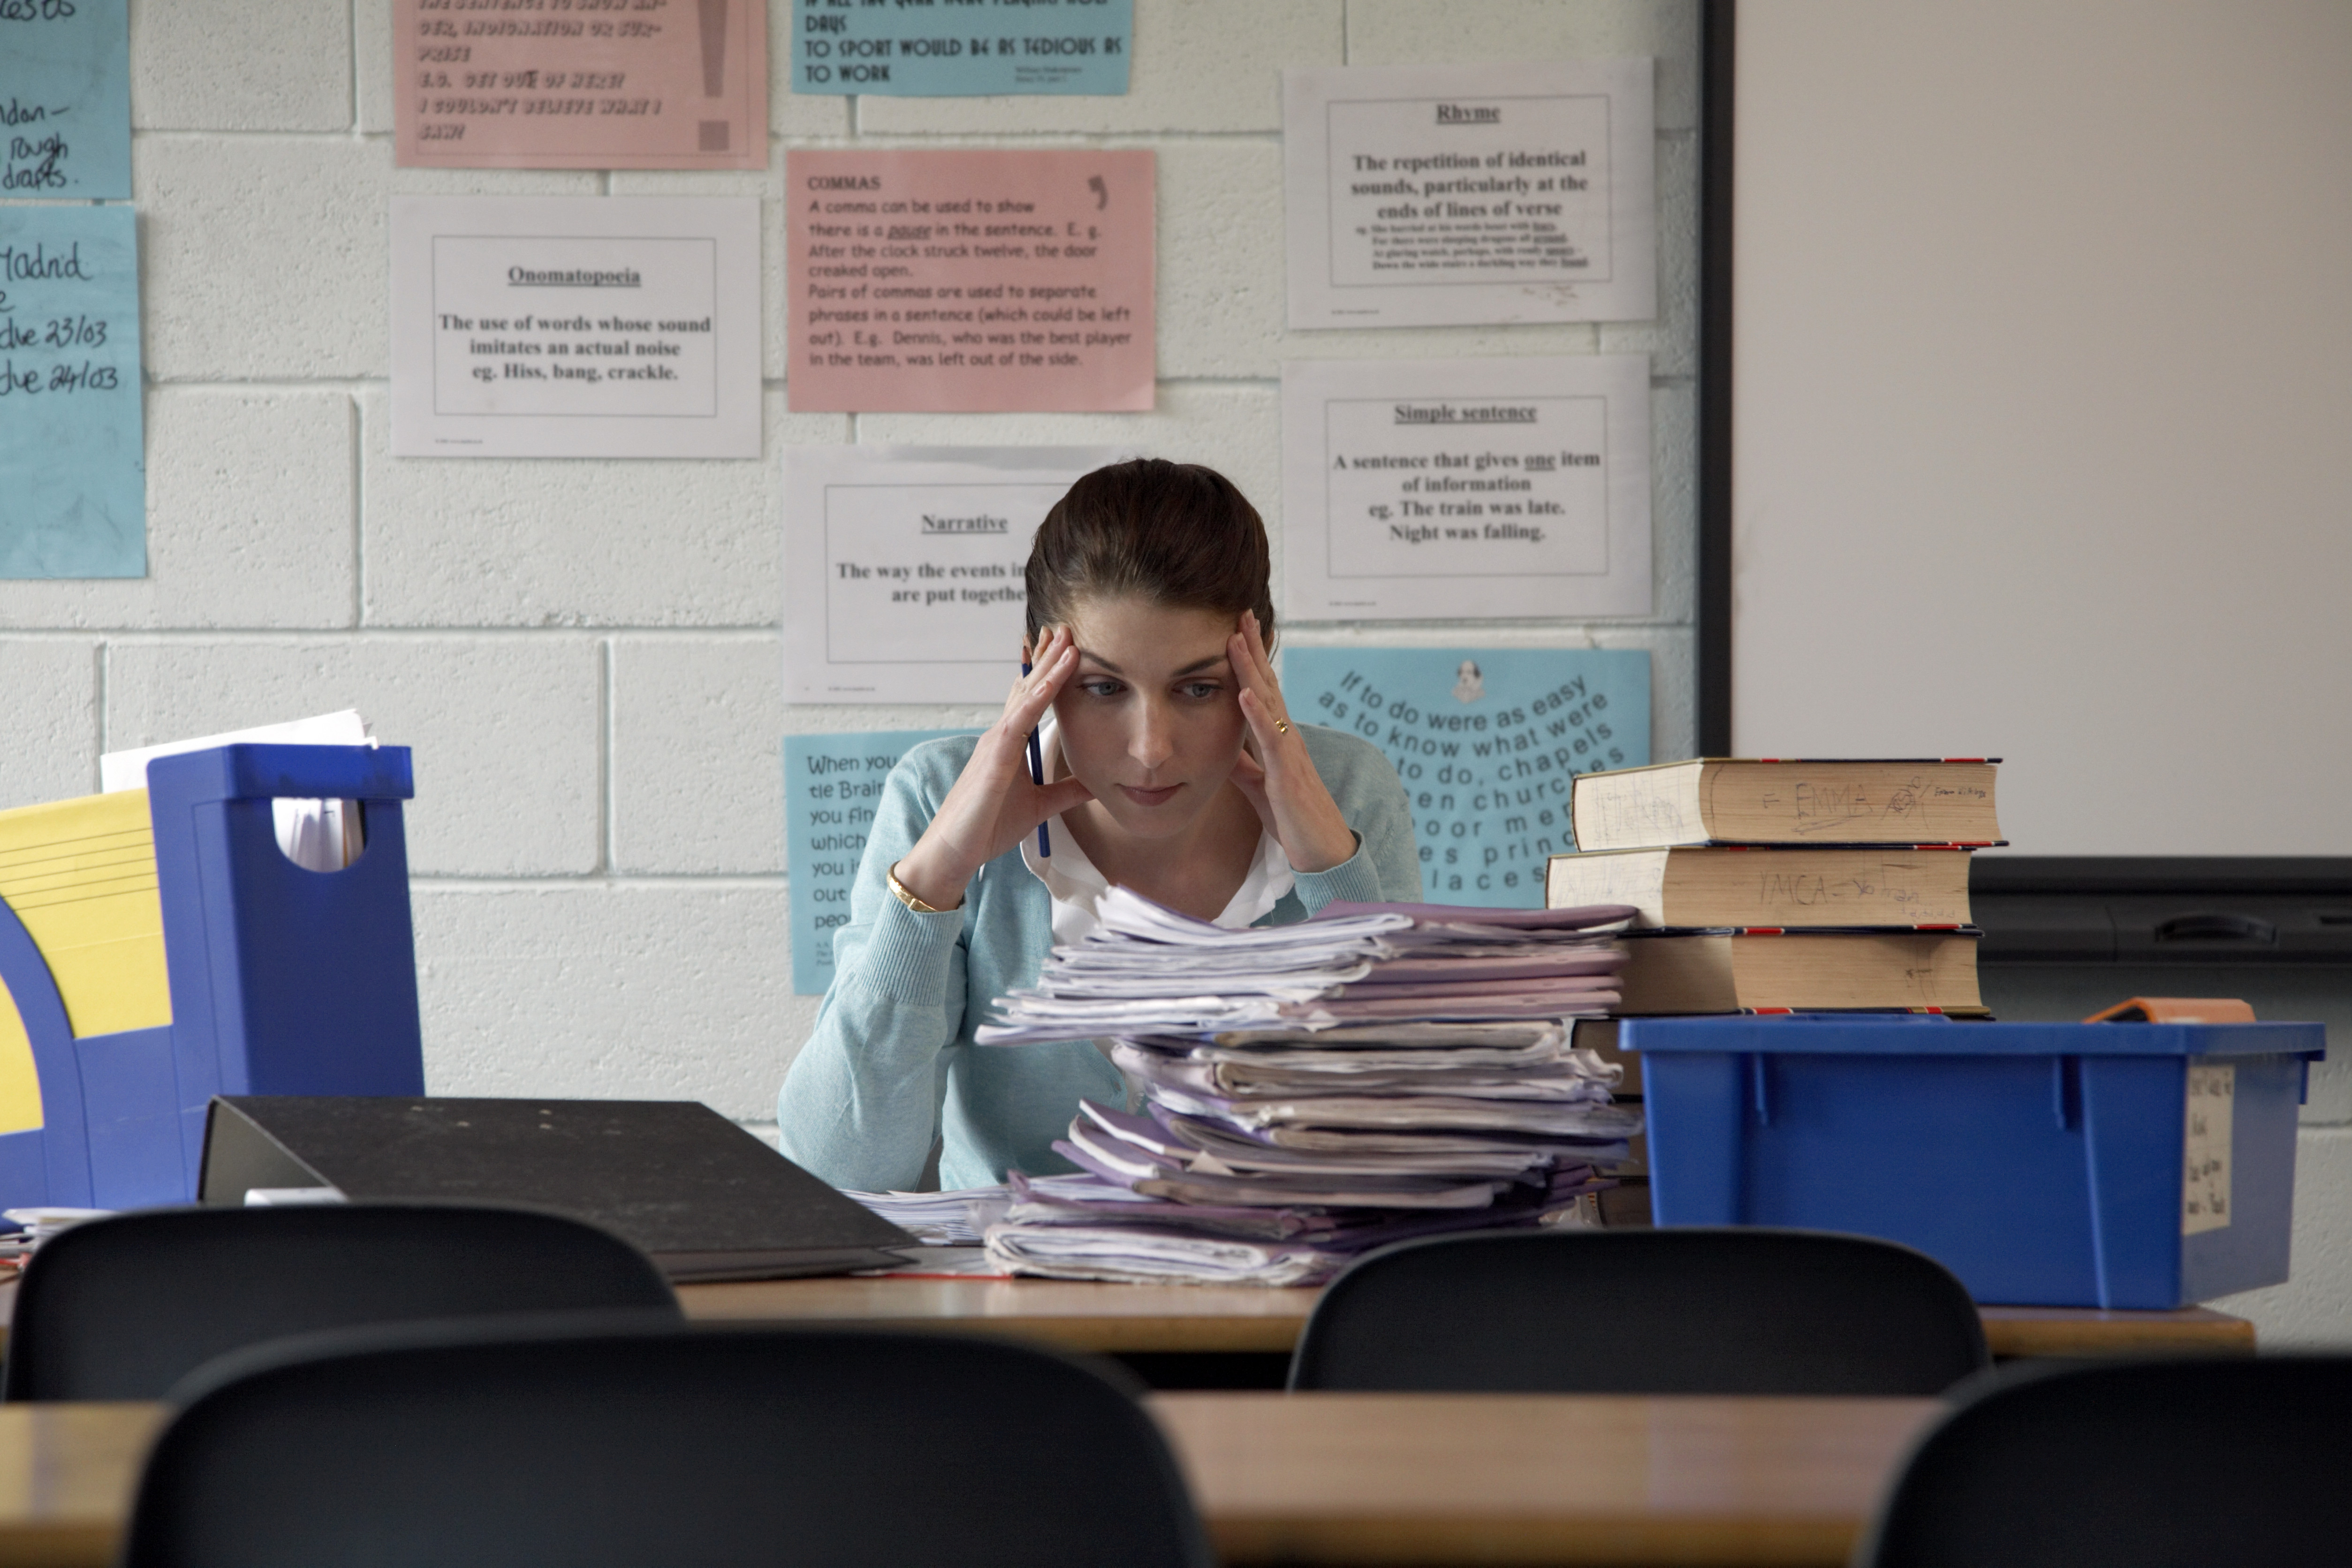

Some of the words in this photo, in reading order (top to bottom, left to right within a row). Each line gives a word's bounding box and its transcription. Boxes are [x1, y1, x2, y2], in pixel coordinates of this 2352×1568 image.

[804, 39, 832, 59] TO
[838, 39, 892, 58] SPORT
[899, 38, 963, 57] WOULD
[970, 38, 989, 56] BE
[998, 38, 1015, 55] AS
[1023, 37, 1096, 56] TEDIOUS
[1104, 37, 1121, 54] AS
[804, 64, 832, 83] TO
[839, 64, 890, 83] WORK
[1436, 104, 1500, 125] Rhyme
[12, 132, 68, 165] rough
[1354, 155, 1388, 171] The
[1393, 153, 1480, 174] repetition
[1485, 151, 1504, 168] of
[1508, 151, 1586, 167] identical
[807, 176, 880, 190] COMMAS
[1351, 178, 1419, 195] sounds,
[1424, 176, 1530, 198] particularly
[1537, 178, 1554, 191] at
[1560, 175, 1588, 191] the
[809, 200, 819, 212] A
[825, 202, 877, 214] comma
[881, 201, 908, 214] can
[911, 200, 931, 213] be
[935, 199, 971, 213] used
[997, 199, 1035, 213] show
[1377, 203, 1419, 219] ends
[1423, 201, 1443, 218] of
[1446, 202, 1487, 218] lines
[1492, 200, 1512, 216] of
[1516, 204, 1562, 216] verse
[809, 223, 851, 237] there
[887, 225, 933, 241] pause
[954, 222, 979, 236] the
[984, 223, 1056, 237] sentence.
[808, 244, 846, 258] After
[851, 244, 876, 258] the
[880, 244, 919, 258] clock
[924, 243, 970, 258] struck
[973, 243, 1028, 258] twelve,
[1034, 244, 1060, 258] the
[1063, 244, 1097, 258] door
[508, 267, 641, 288] Onomatopoeia
[808, 264, 868, 278] creaked
[872, 266, 913, 280] open.
[808, 283, 847, 299] Pairs
[873, 287, 933, 299] commas
[936, 287, 963, 299] are
[967, 284, 1004, 299] used
[1029, 285, 1096, 302] separate
[439, 314, 473, 330] The
[479, 319, 508, 331] use
[513, 315, 533, 331] of
[537, 316, 592, 332] words
[598, 316, 652, 332] whose
[658, 317, 711, 333] sound
[808, 308, 869, 325] phrases
[905, 309, 974, 322] sentence
[978, 307, 1028, 324] (which
[1032, 307, 1073, 322] could
[1077, 308, 1096, 322] be
[1101, 306, 1130, 322] left
[45, 315, 108, 348] 23/03
[892, 330, 947, 346] Dennis,
[952, 331, 983, 345] who
[987, 333, 1016, 345] was
[1019, 331, 1045, 345] the
[1048, 331, 1080, 345] best
[1085, 331, 1131, 347] player
[470, 339, 542, 355] imitates
[547, 343, 569, 355] an
[575, 340, 630, 356] actual
[635, 341, 681, 356] noise
[827, 352, 853, 366] the
[857, 353, 900, 367] team,
[906, 355, 934, 366] was
[939, 351, 964, 366] left
[969, 353, 994, 366] out
[1018, 352, 1044, 366] the
[1048, 352, 1081, 366] side.
[50, 360, 119, 394] 24/03
[472, 367, 497, 383] eg.
[504, 363, 547, 380] Hiss,
[553, 364, 602, 383] bang,
[607, 364, 678, 380] crackle.
[1395, 404, 1459, 425] Simple
[1459, 406, 1537, 424] sentence
[1335, 455, 1347, 470] A
[1352, 455, 1428, 469] sentence
[1434, 453, 1469, 468] that
[1474, 452, 1519, 472] gives
[1524, 455, 1555, 472] one
[1561, 452, 1601, 466] item
[1402, 476, 1421, 492] of
[1425, 476, 1532, 492] information
[1368, 505, 1393, 521] eg.
[1401, 500, 1434, 516] The
[1439, 500, 1483, 515] train
[1489, 503, 1522, 515] was
[1527, 499, 1565, 515] late.
[922, 515, 1008, 535] Narrative
[1390, 524, 1439, 544] Night
[1445, 528, 1478, 540] was
[1483, 523, 1545, 543] falling.
[837, 563, 871, 579] The
[876, 567, 910, 582] way
[918, 563, 945, 578] the
[950, 564, 1006, 578] events
[892, 591, 920, 602] are
[926, 588, 956, 606] put
[1340, 670, 1363, 694] If
[1359, 685, 1383, 709] to
[1389, 698, 1419, 724] do
[1428, 712, 1487, 732] were
[1497, 704, 1525, 728] as
[1533, 674, 1587, 716] easy
[1317, 690, 1347, 720] as
[1354, 714, 1379, 736] to
[1388, 726, 1460, 757] know
[1473, 728, 1539, 757] what
[1547, 691, 1608, 738] were
[1397, 756, 1422, 779] to
[1438, 764, 1485, 786] do,
[1498, 721, 1612, 781] chapels
[806, 755, 860, 775] When
[865, 755, 896, 771] you
[1796, 783, 1874, 819] EMMA
[809, 810, 842, 826] you
[811, 834, 866, 850] which
[812, 862, 844, 878] you
[813, 888, 847, 903] out
[1760, 871, 1827, 904] YMCA
